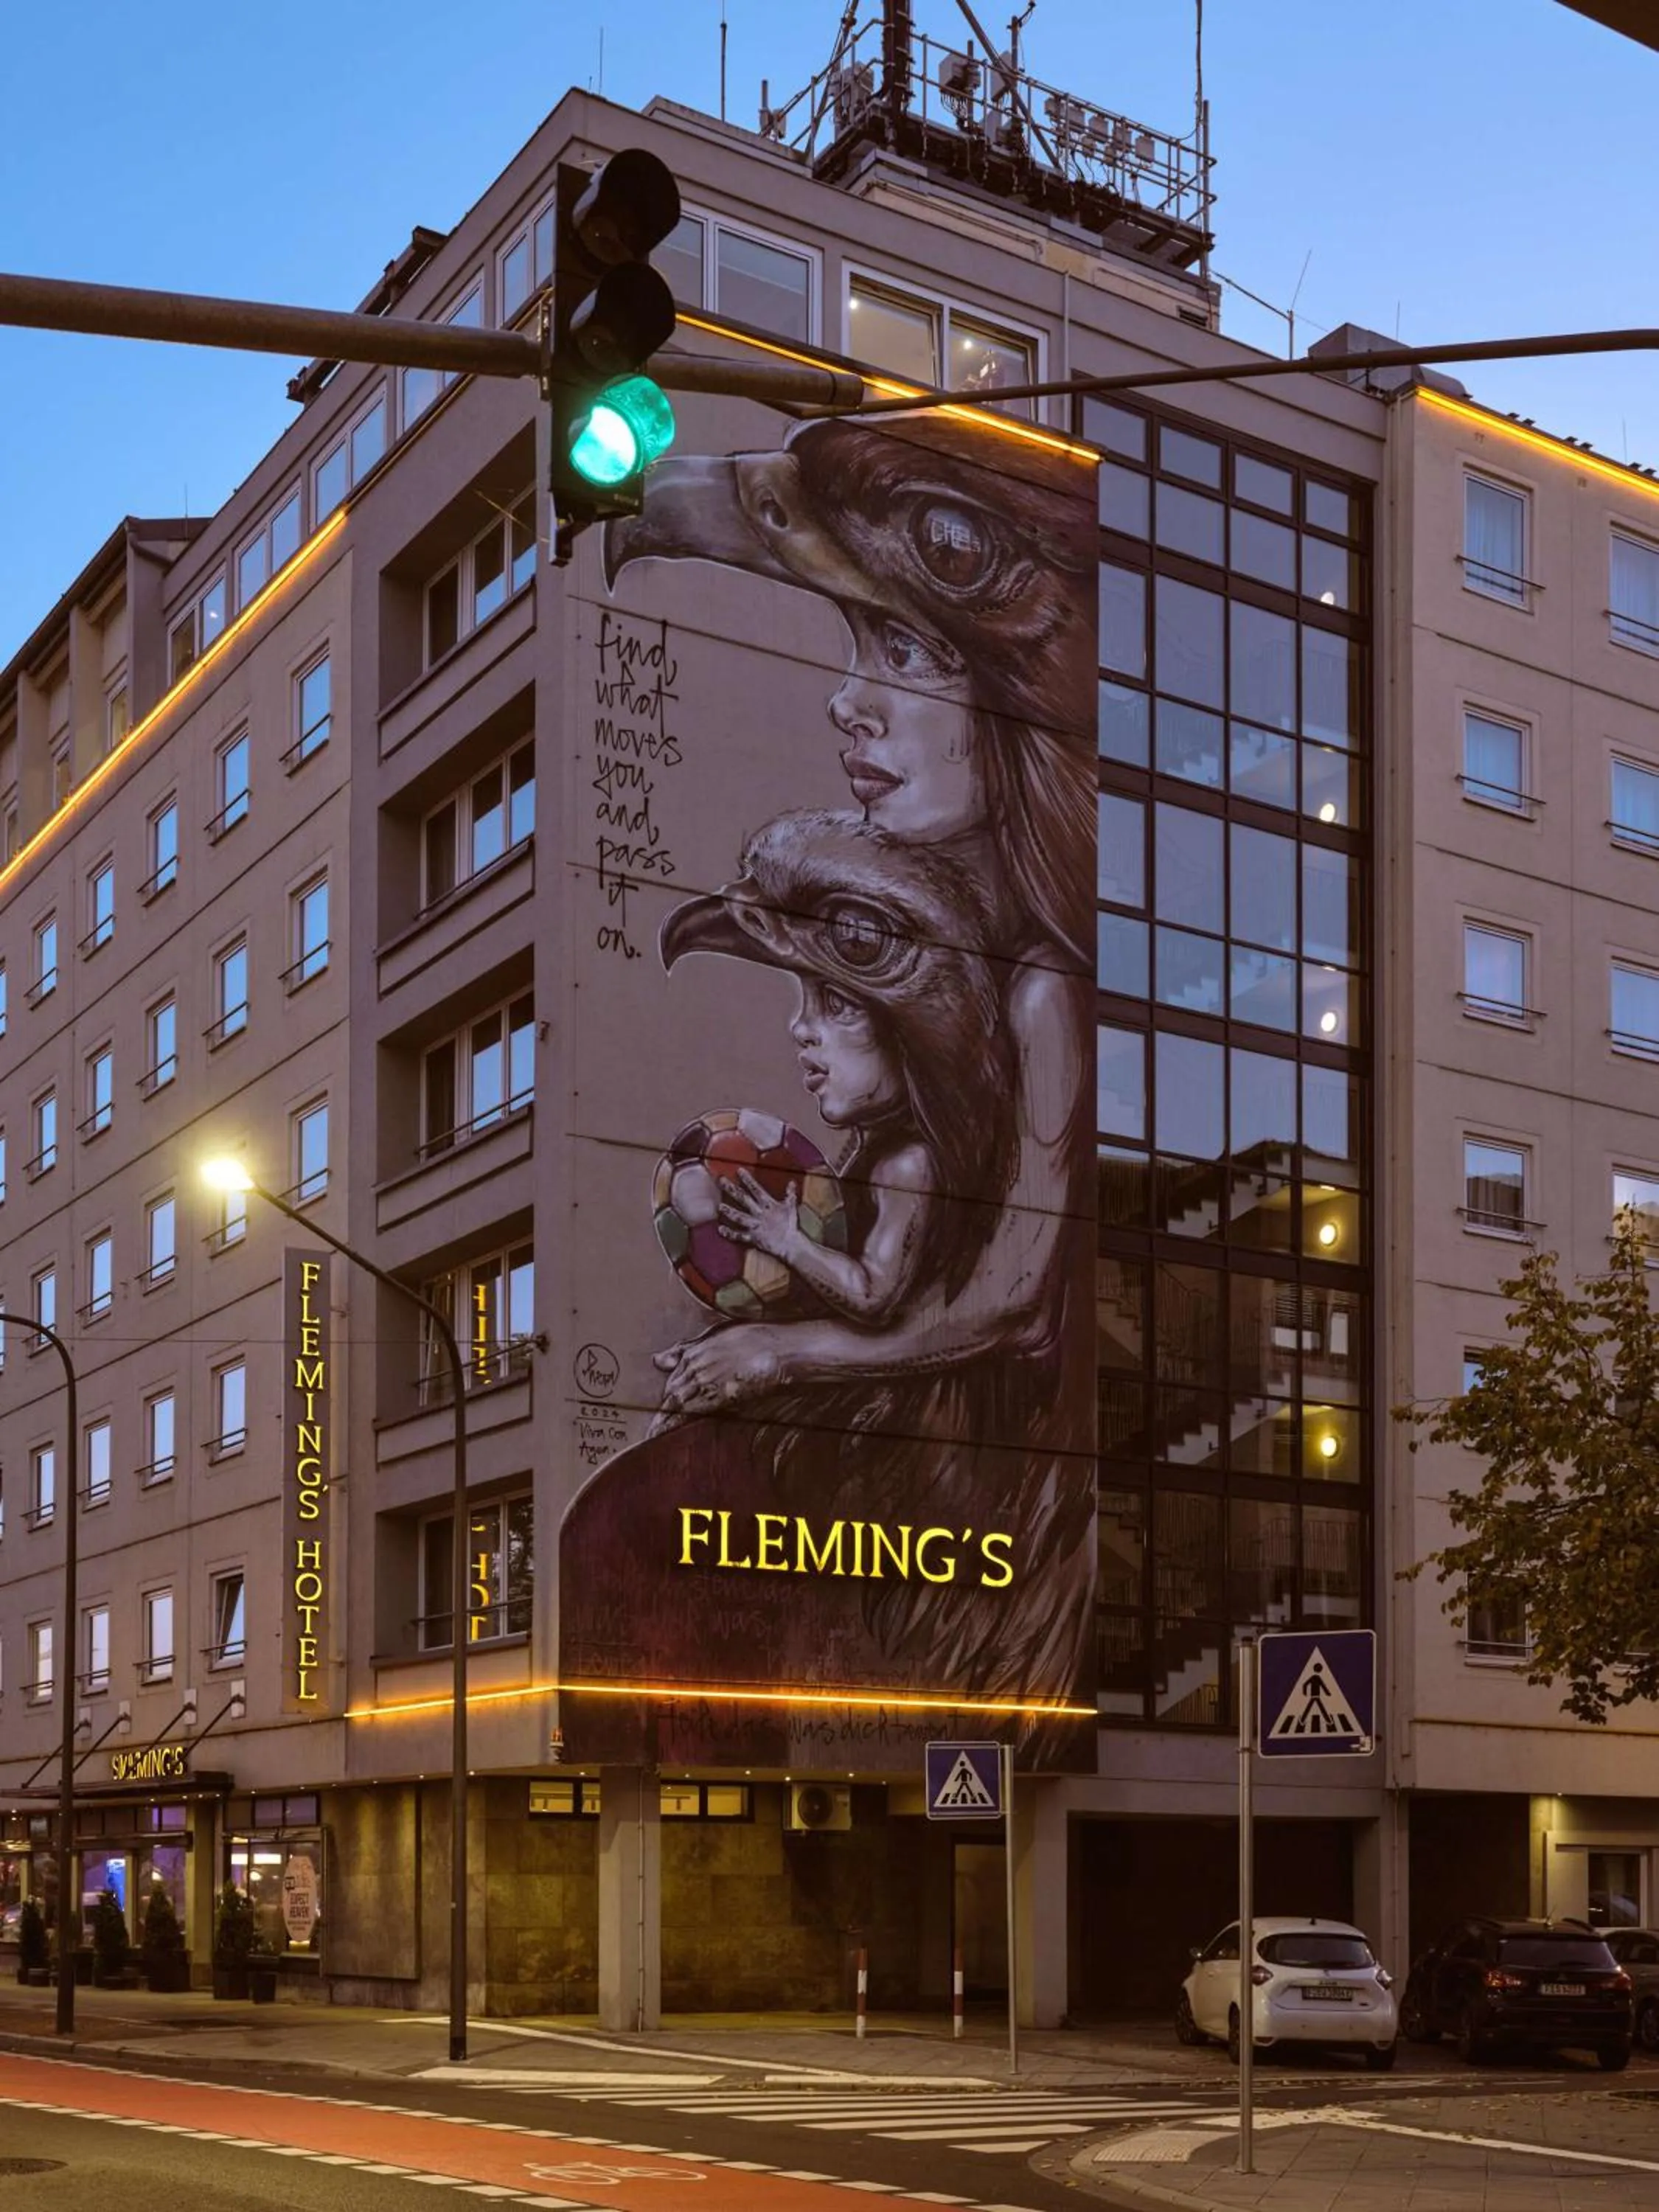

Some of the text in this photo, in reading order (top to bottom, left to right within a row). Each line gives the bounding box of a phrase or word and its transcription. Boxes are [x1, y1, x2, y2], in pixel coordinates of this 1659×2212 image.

[594, 612, 678, 686] find
[594, 660, 679, 737] what
[594, 718, 683, 766] moves
[592, 754, 653, 800] you
[596, 796, 659, 845] and
[597, 835, 675, 889] pass
[608, 873, 639, 927] it
[597, 925, 641, 958] on.
[294, 1262, 329, 1700] FLEMING'S HOTEL
[678, 1508, 1014, 1587] FLEMING'S
